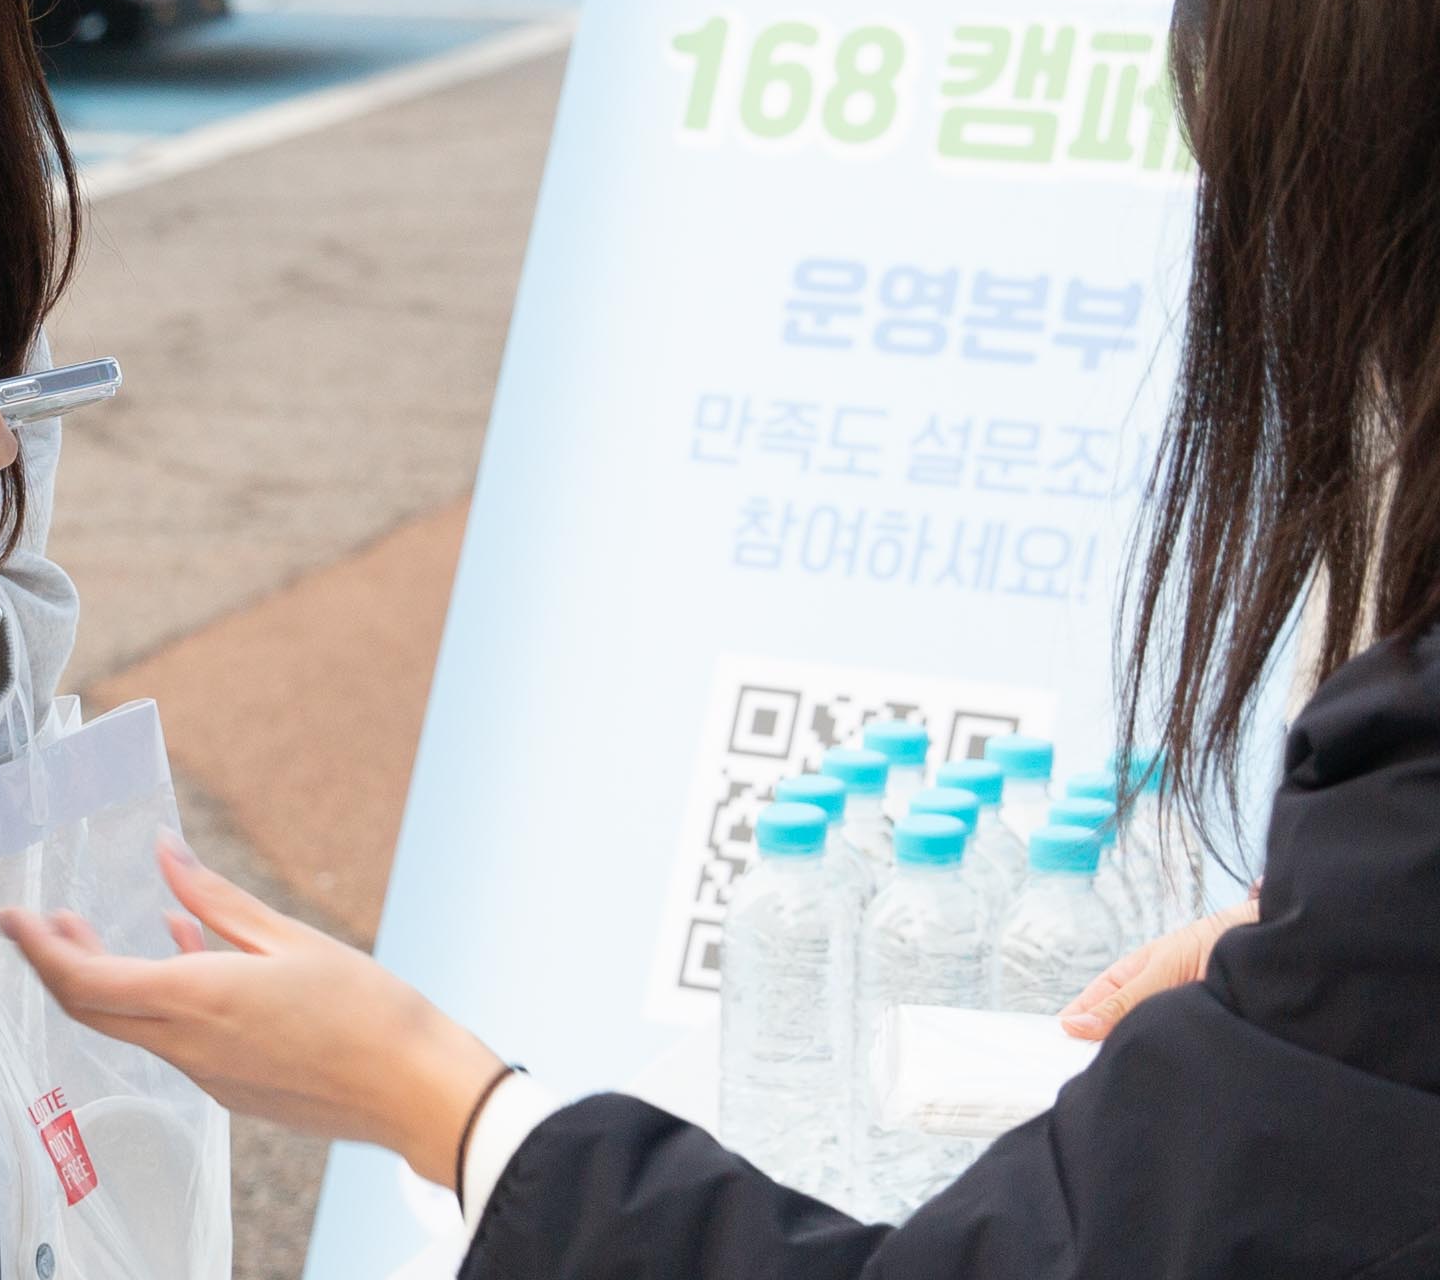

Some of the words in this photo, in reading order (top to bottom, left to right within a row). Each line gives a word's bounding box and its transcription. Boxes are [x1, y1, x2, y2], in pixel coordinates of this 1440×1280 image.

[671, 15, 907, 145] 168
[780, 256, 1144, 373] 운영본부
[690, 390, 889, 481] 만족도
[731, 496, 1098, 605] 참여하세요!
[27, 1086, 68, 1126] LOTTE
[48, 1124, 78, 1163] DUTY
[60, 1153, 91, 1191] FREE
